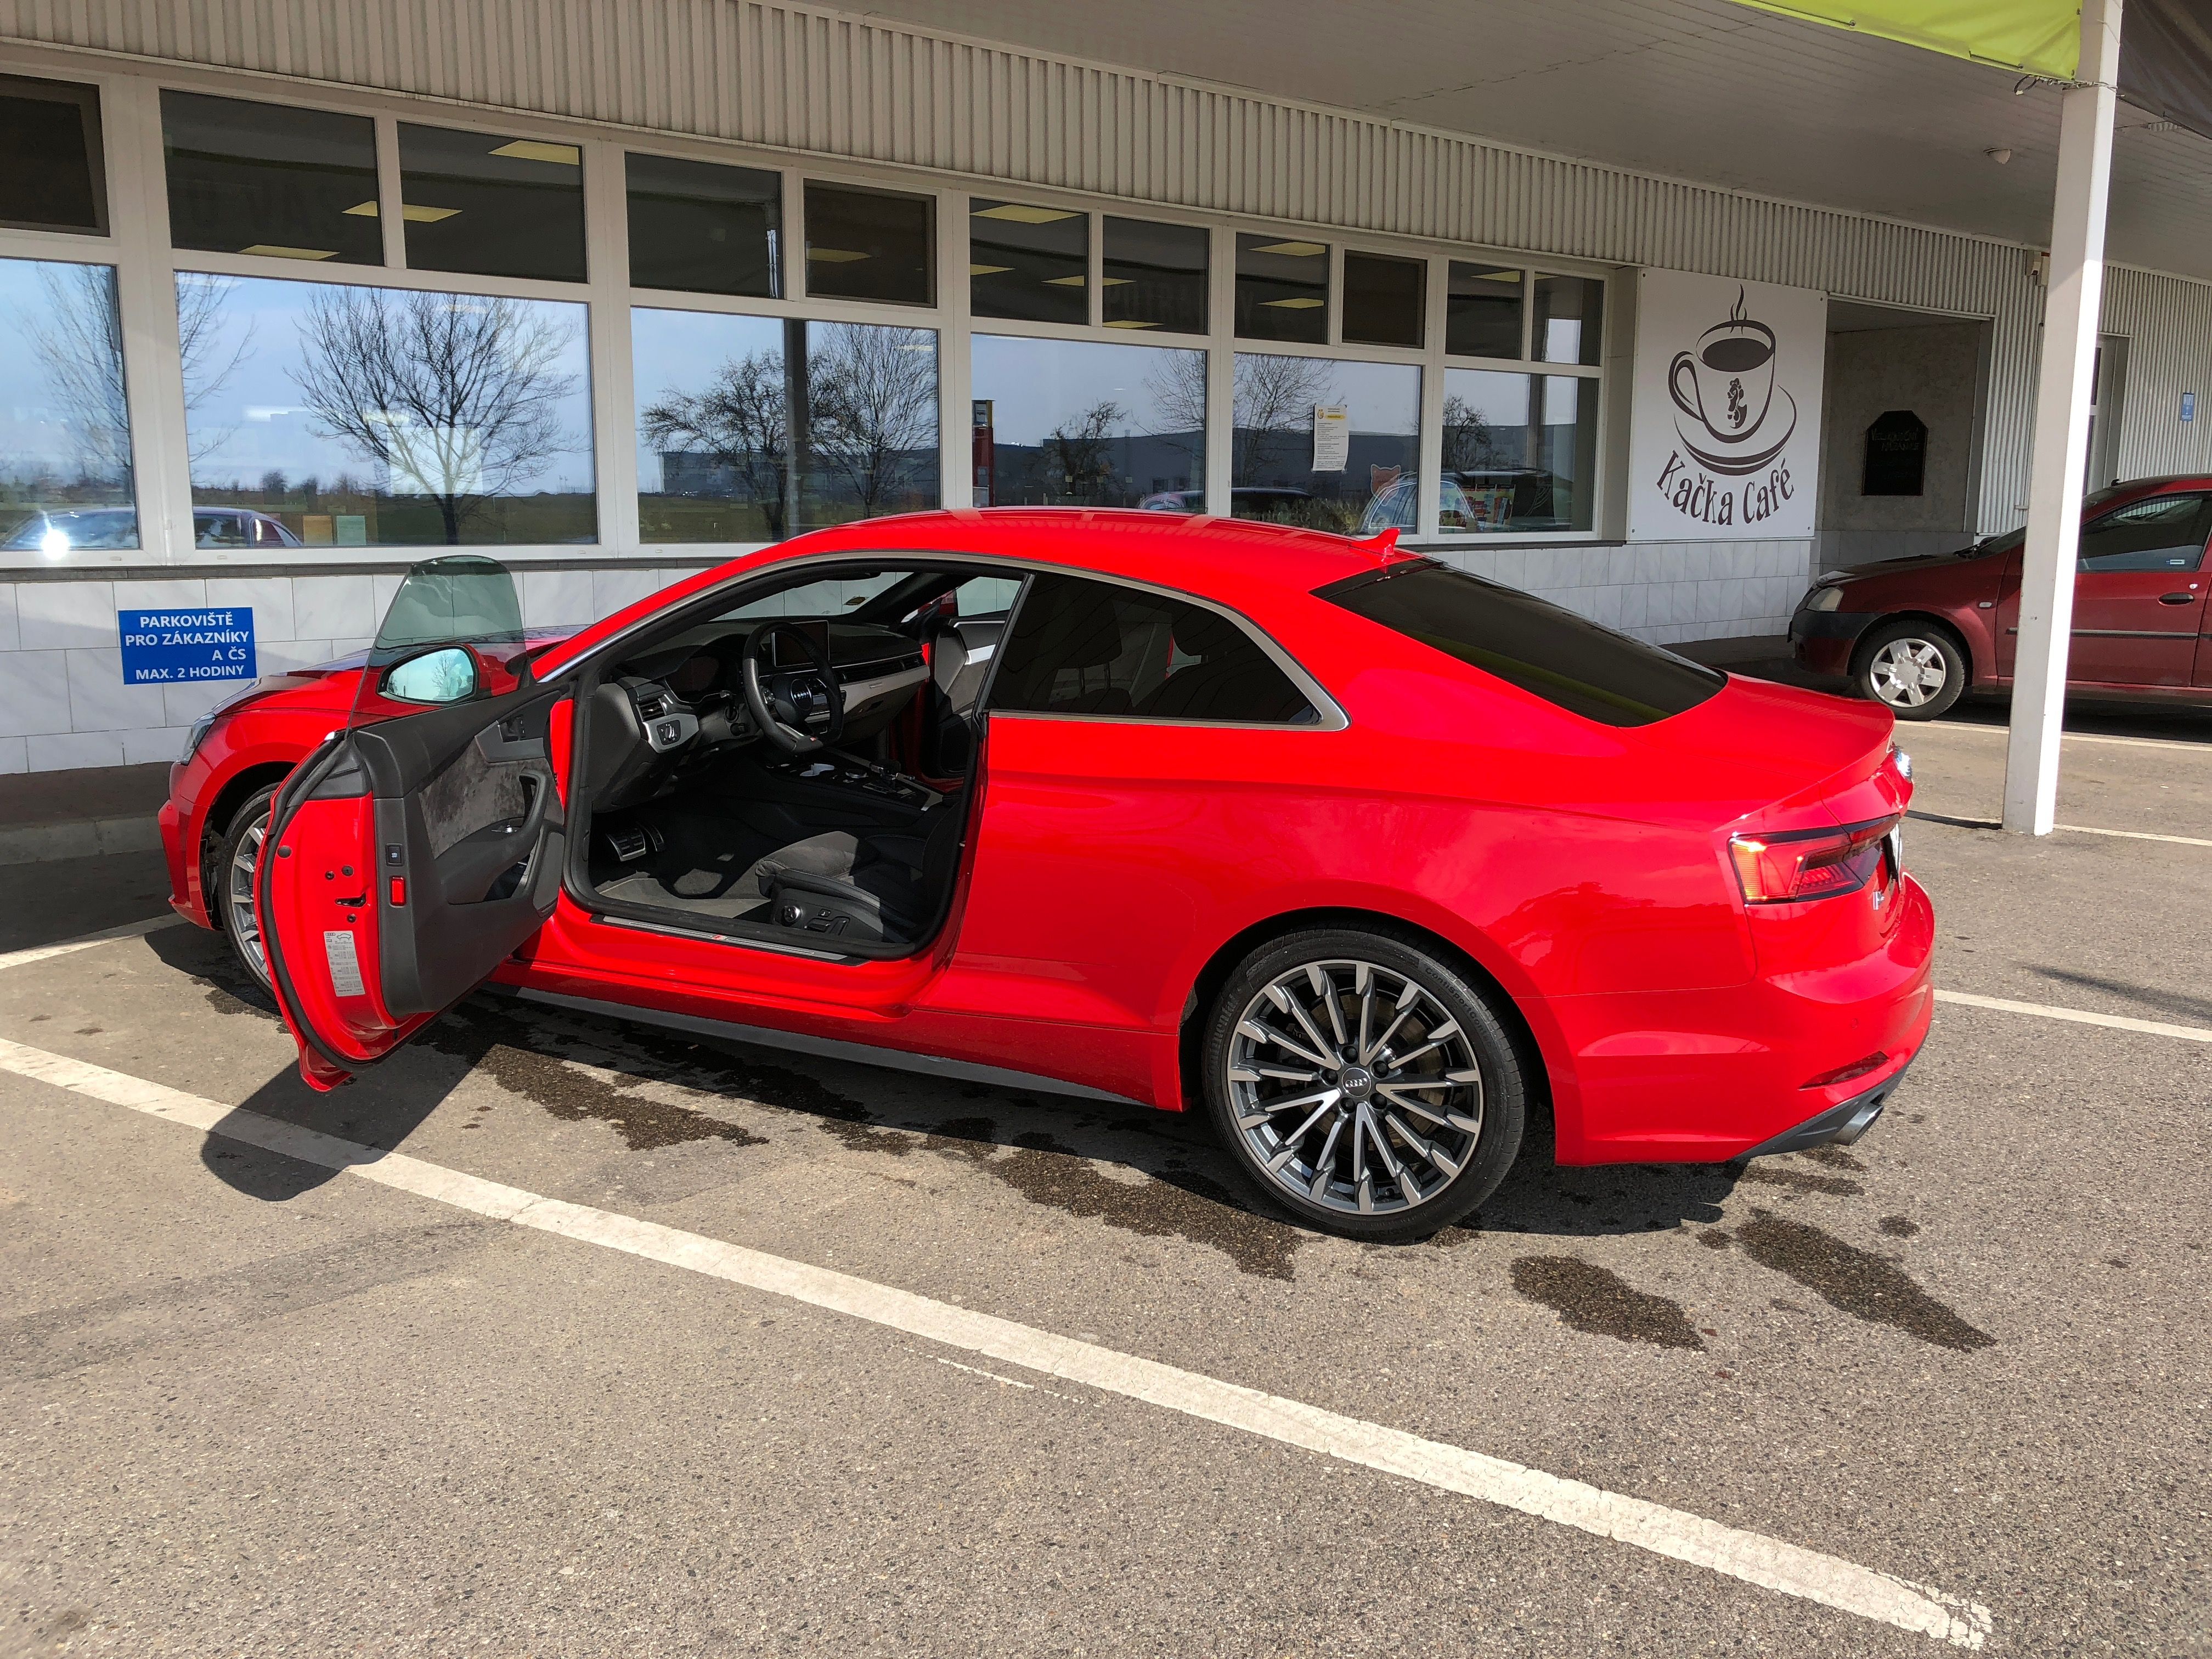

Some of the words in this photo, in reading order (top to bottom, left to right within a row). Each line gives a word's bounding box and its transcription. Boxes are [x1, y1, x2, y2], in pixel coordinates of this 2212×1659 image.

[1657, 450, 1733, 526] Kačka
[1743, 458, 1795, 524] Café
[140, 611, 234, 628] PARKOVIŠTĚ
[125, 634, 157, 646] PRO
[162, 629, 249, 645] ZÁKAZNÍKY
[212, 650, 223, 661] A
[228, 646, 246, 660] ČS
[136, 668, 173, 680] MAX.
[177, 668, 185, 678] 2
[189, 665, 244, 678] HODINY
